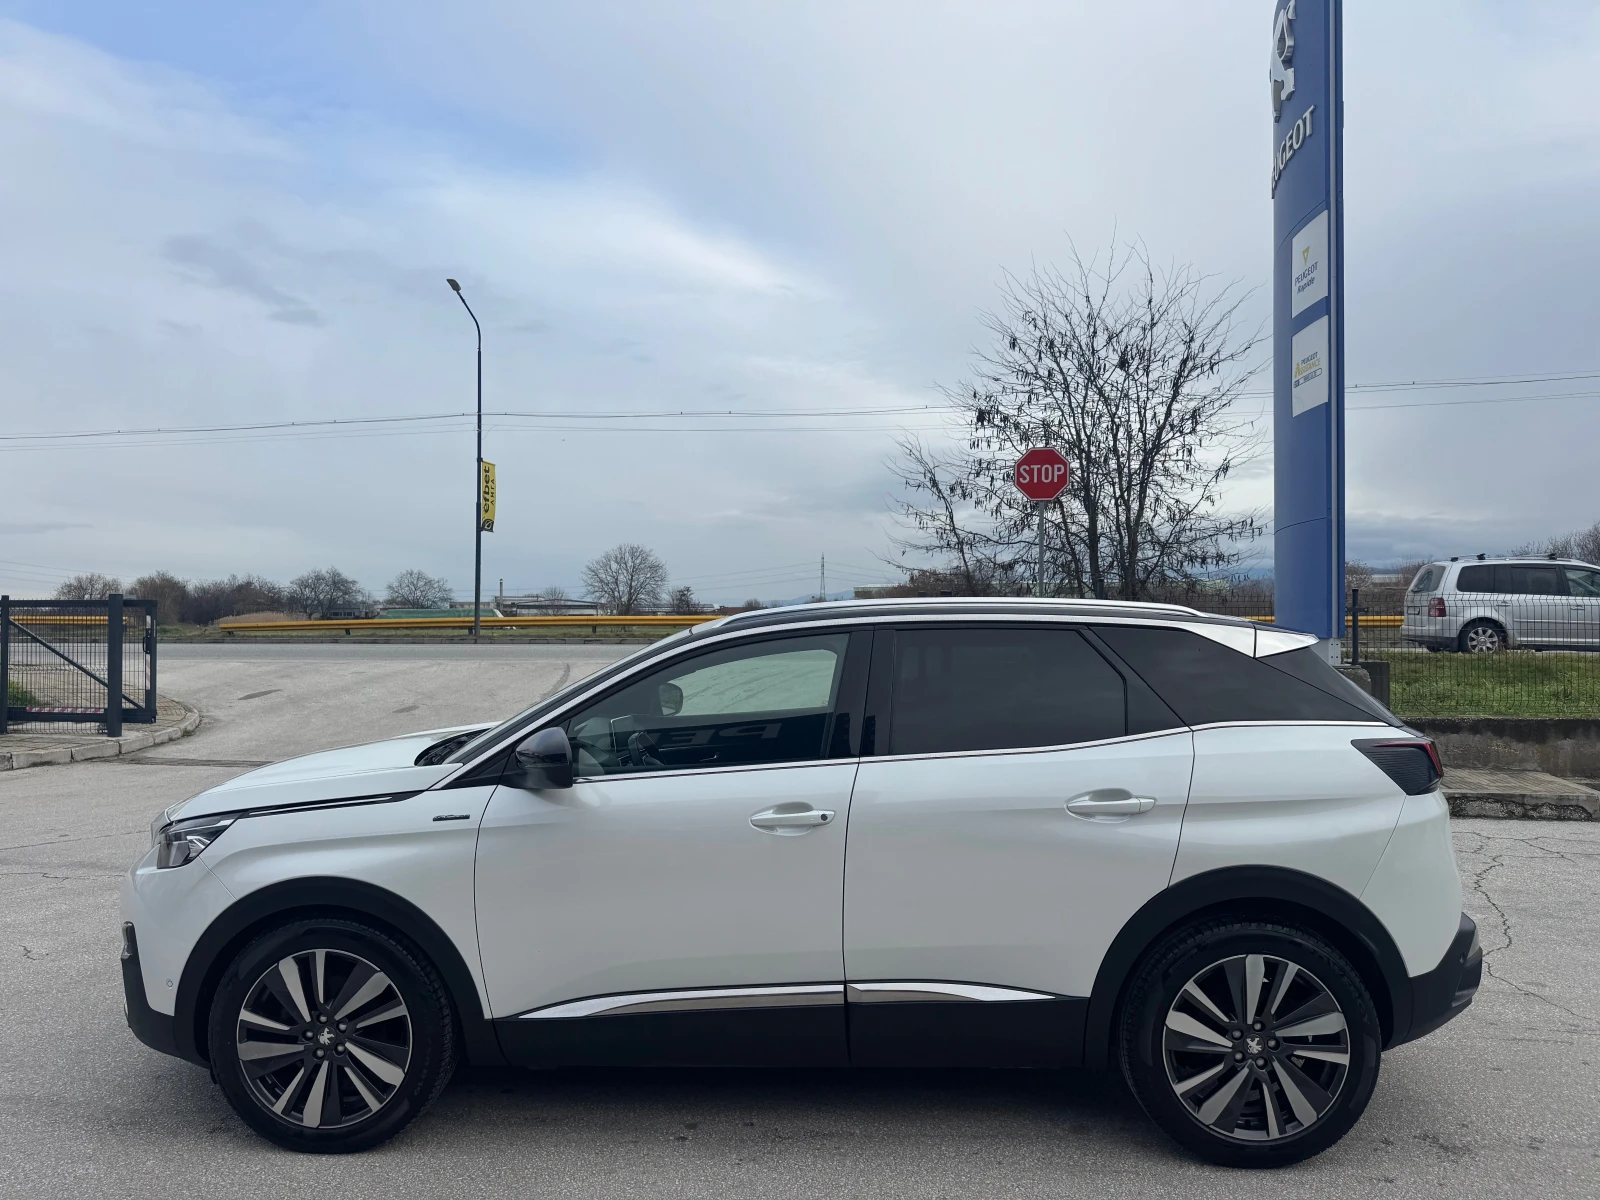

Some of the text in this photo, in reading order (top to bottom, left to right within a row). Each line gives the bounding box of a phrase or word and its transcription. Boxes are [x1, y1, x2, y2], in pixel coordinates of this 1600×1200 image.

[1271, 104, 1315, 199] UGEOT
[1295, 261, 1318, 286] PEUGEOT
[1019, 464, 1065, 483] STOP
